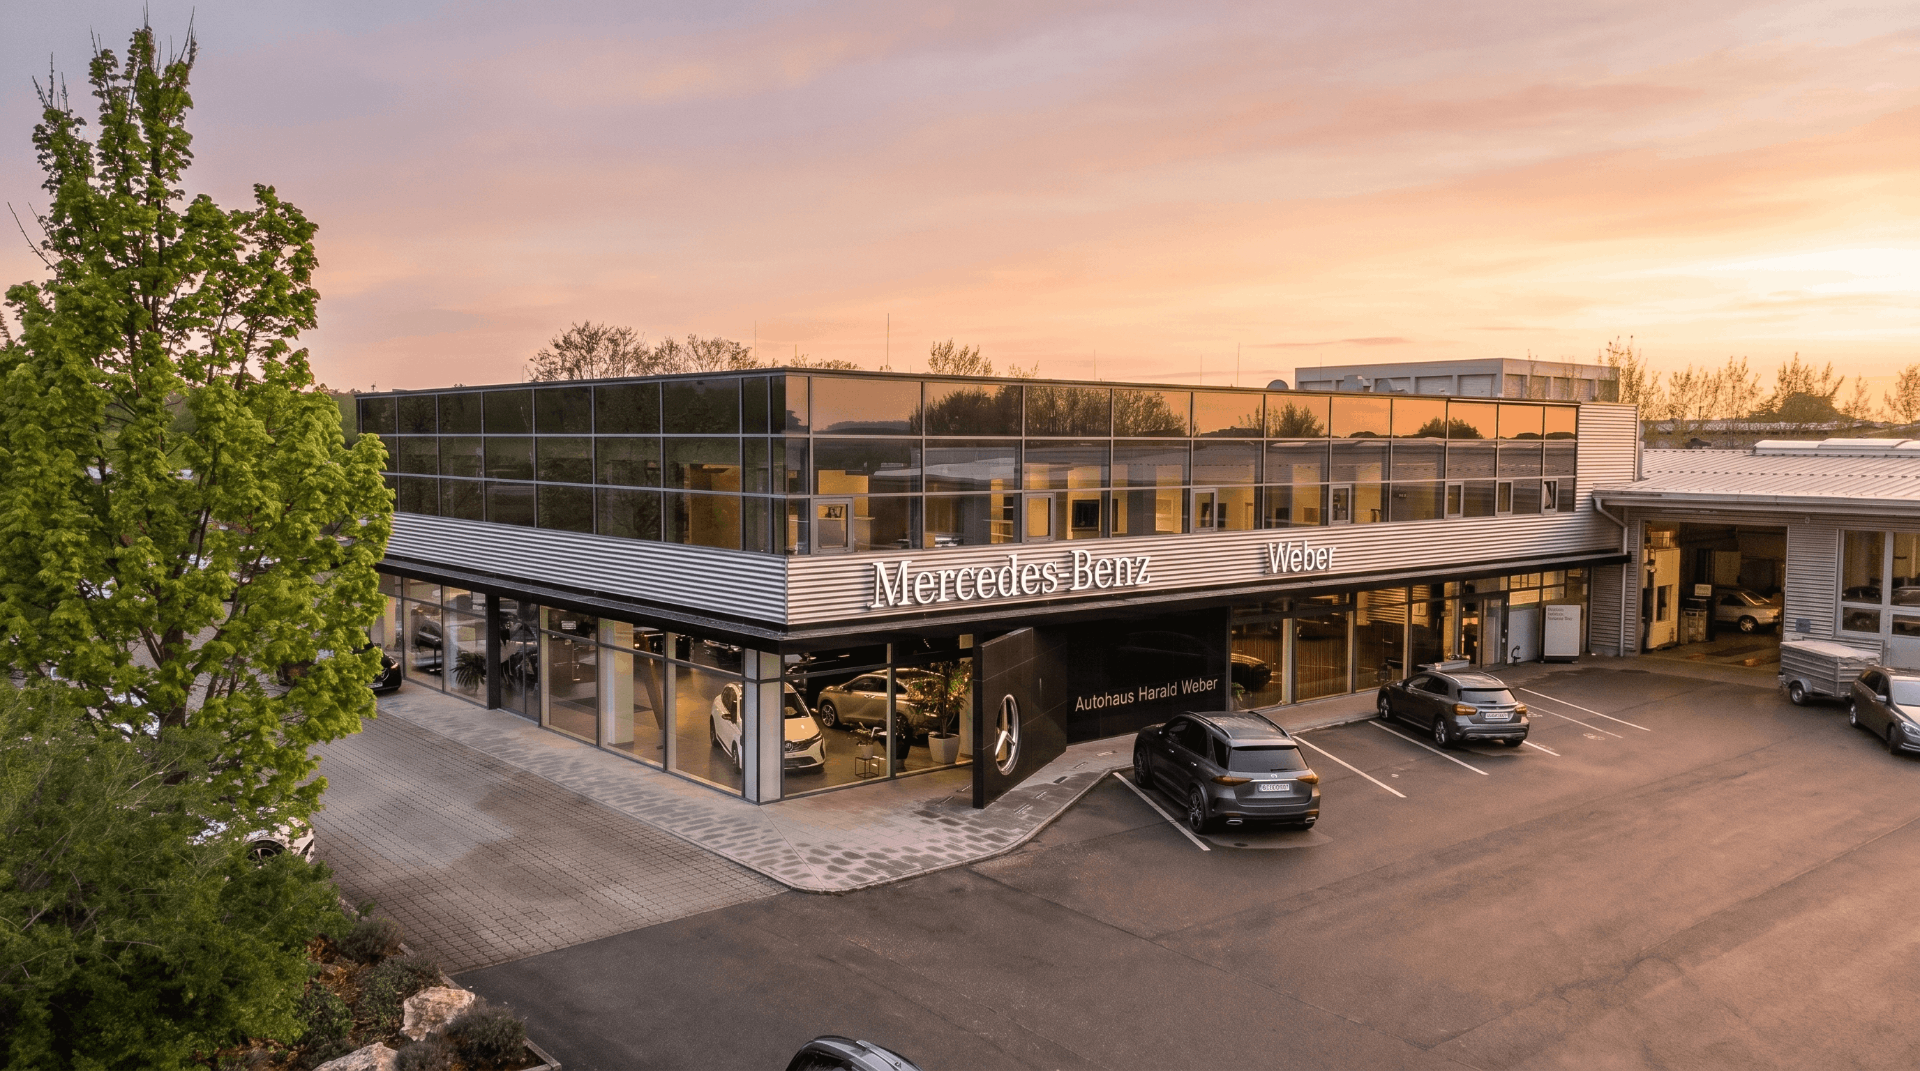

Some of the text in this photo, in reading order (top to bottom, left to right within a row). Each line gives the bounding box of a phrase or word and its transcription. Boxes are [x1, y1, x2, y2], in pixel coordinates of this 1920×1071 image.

[1268, 540, 1336, 573] Weber
[870, 549, 1151, 608] Mercedes-Benz
[1075, 678, 1218, 712] Autohaus Harald Weber
